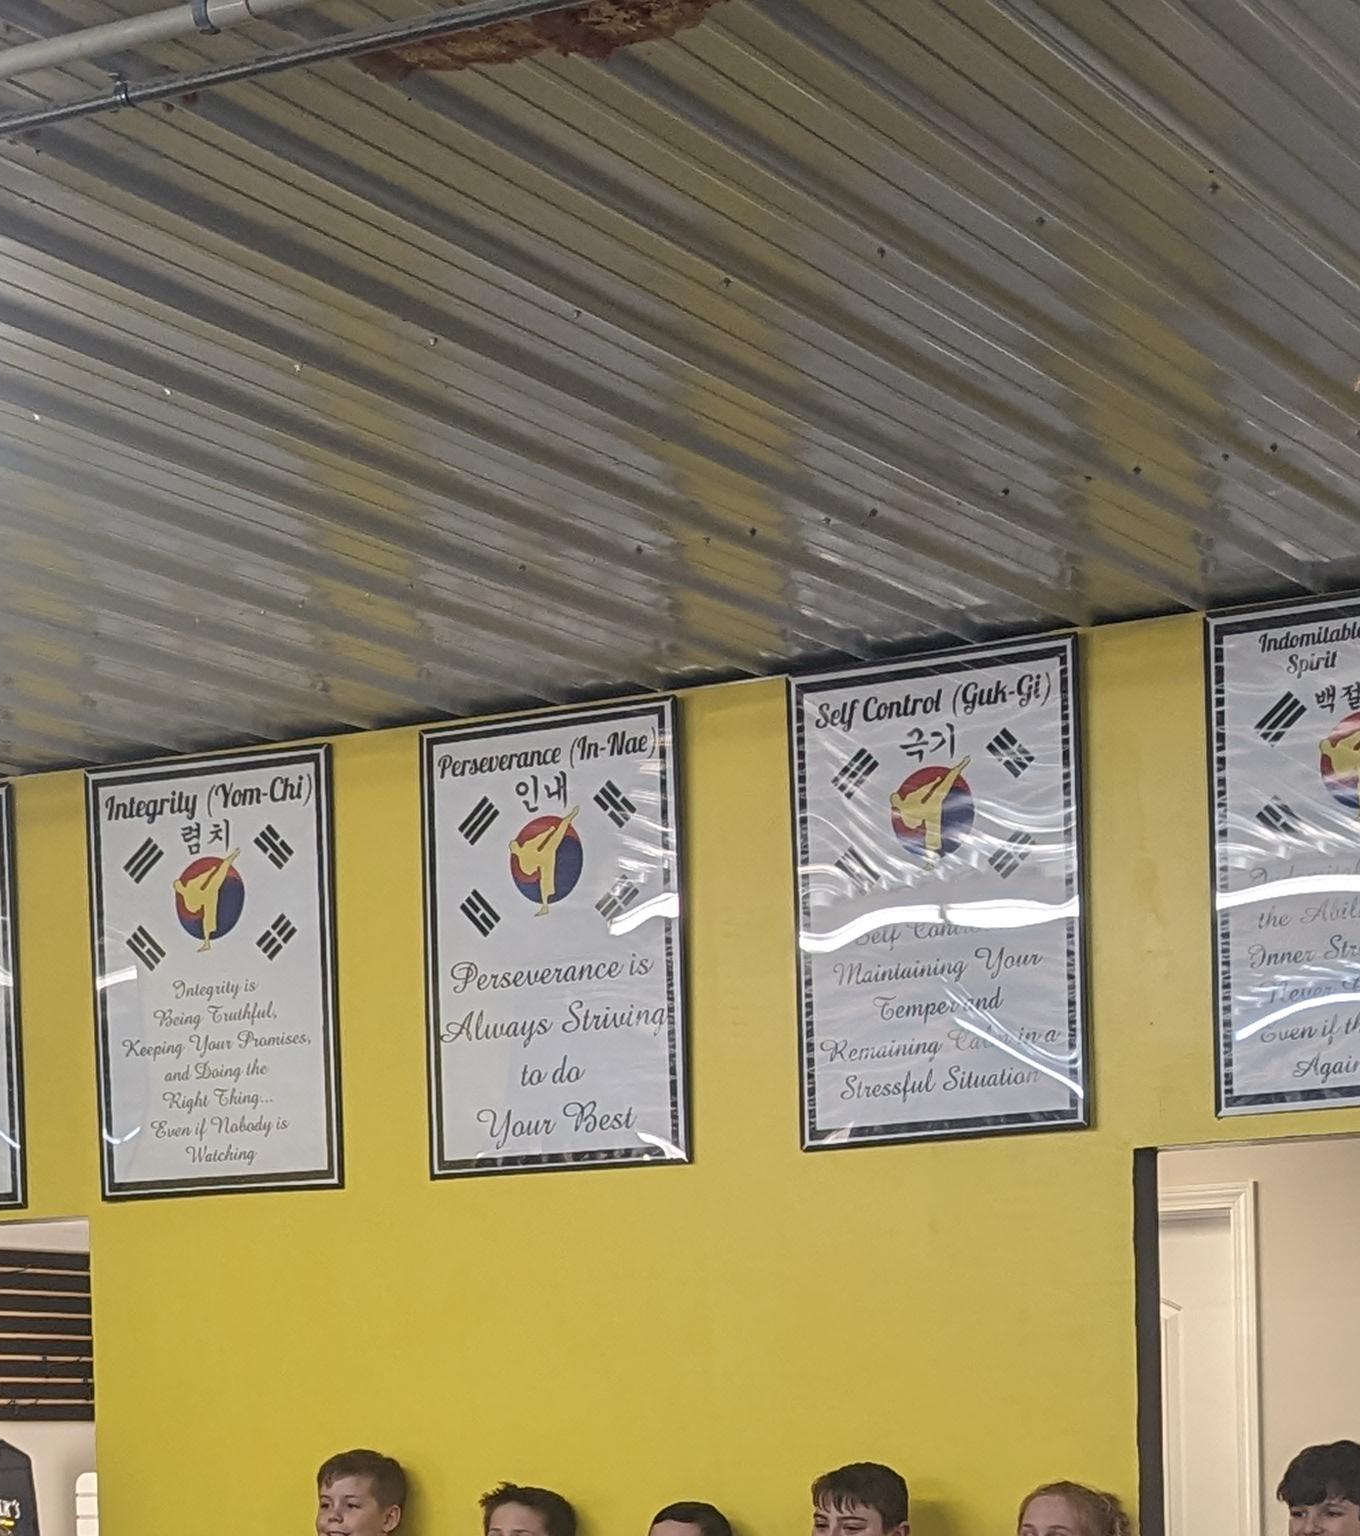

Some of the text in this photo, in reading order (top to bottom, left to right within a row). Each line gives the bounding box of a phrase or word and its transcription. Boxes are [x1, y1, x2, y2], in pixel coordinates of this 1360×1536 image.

[1287, 651, 1338, 679] Spirit
[816, 672, 1051, 730] Self Control (Guk-Gi)
[438, 726, 657, 779] Perseverance (In-Nae)
[900, 723, 956, 763] 극기
[105, 773, 312, 822] Integrity (Yom-Chi)
[516, 771, 568, 813] 인내
[1258, 907, 1291, 929] the
[833, 946, 1042, 985] Maintaining Your
[1248, 944, 1316, 968] Inner
[173, 979, 256, 1001] Integrity is
[451, 955, 653, 994] Perseverance is
[153, 1001, 277, 1030] Being Truthful,
[441, 1000, 666, 1047] Always Striving
[122, 1030, 311, 1061] Keeping Your Promises,
[821, 1038, 942, 1062] Remaining
[165, 1058, 268, 1083] and Doing the
[521, 1055, 585, 1086] to do
[841, 1065, 1040, 1103] Stressful Situation
[163, 1091, 208, 1113] Right
[151, 1115, 288, 1141] Even if Nobody is
[477, 1102, 637, 1149] Your Best
[186, 1144, 257, 1165] Watching
